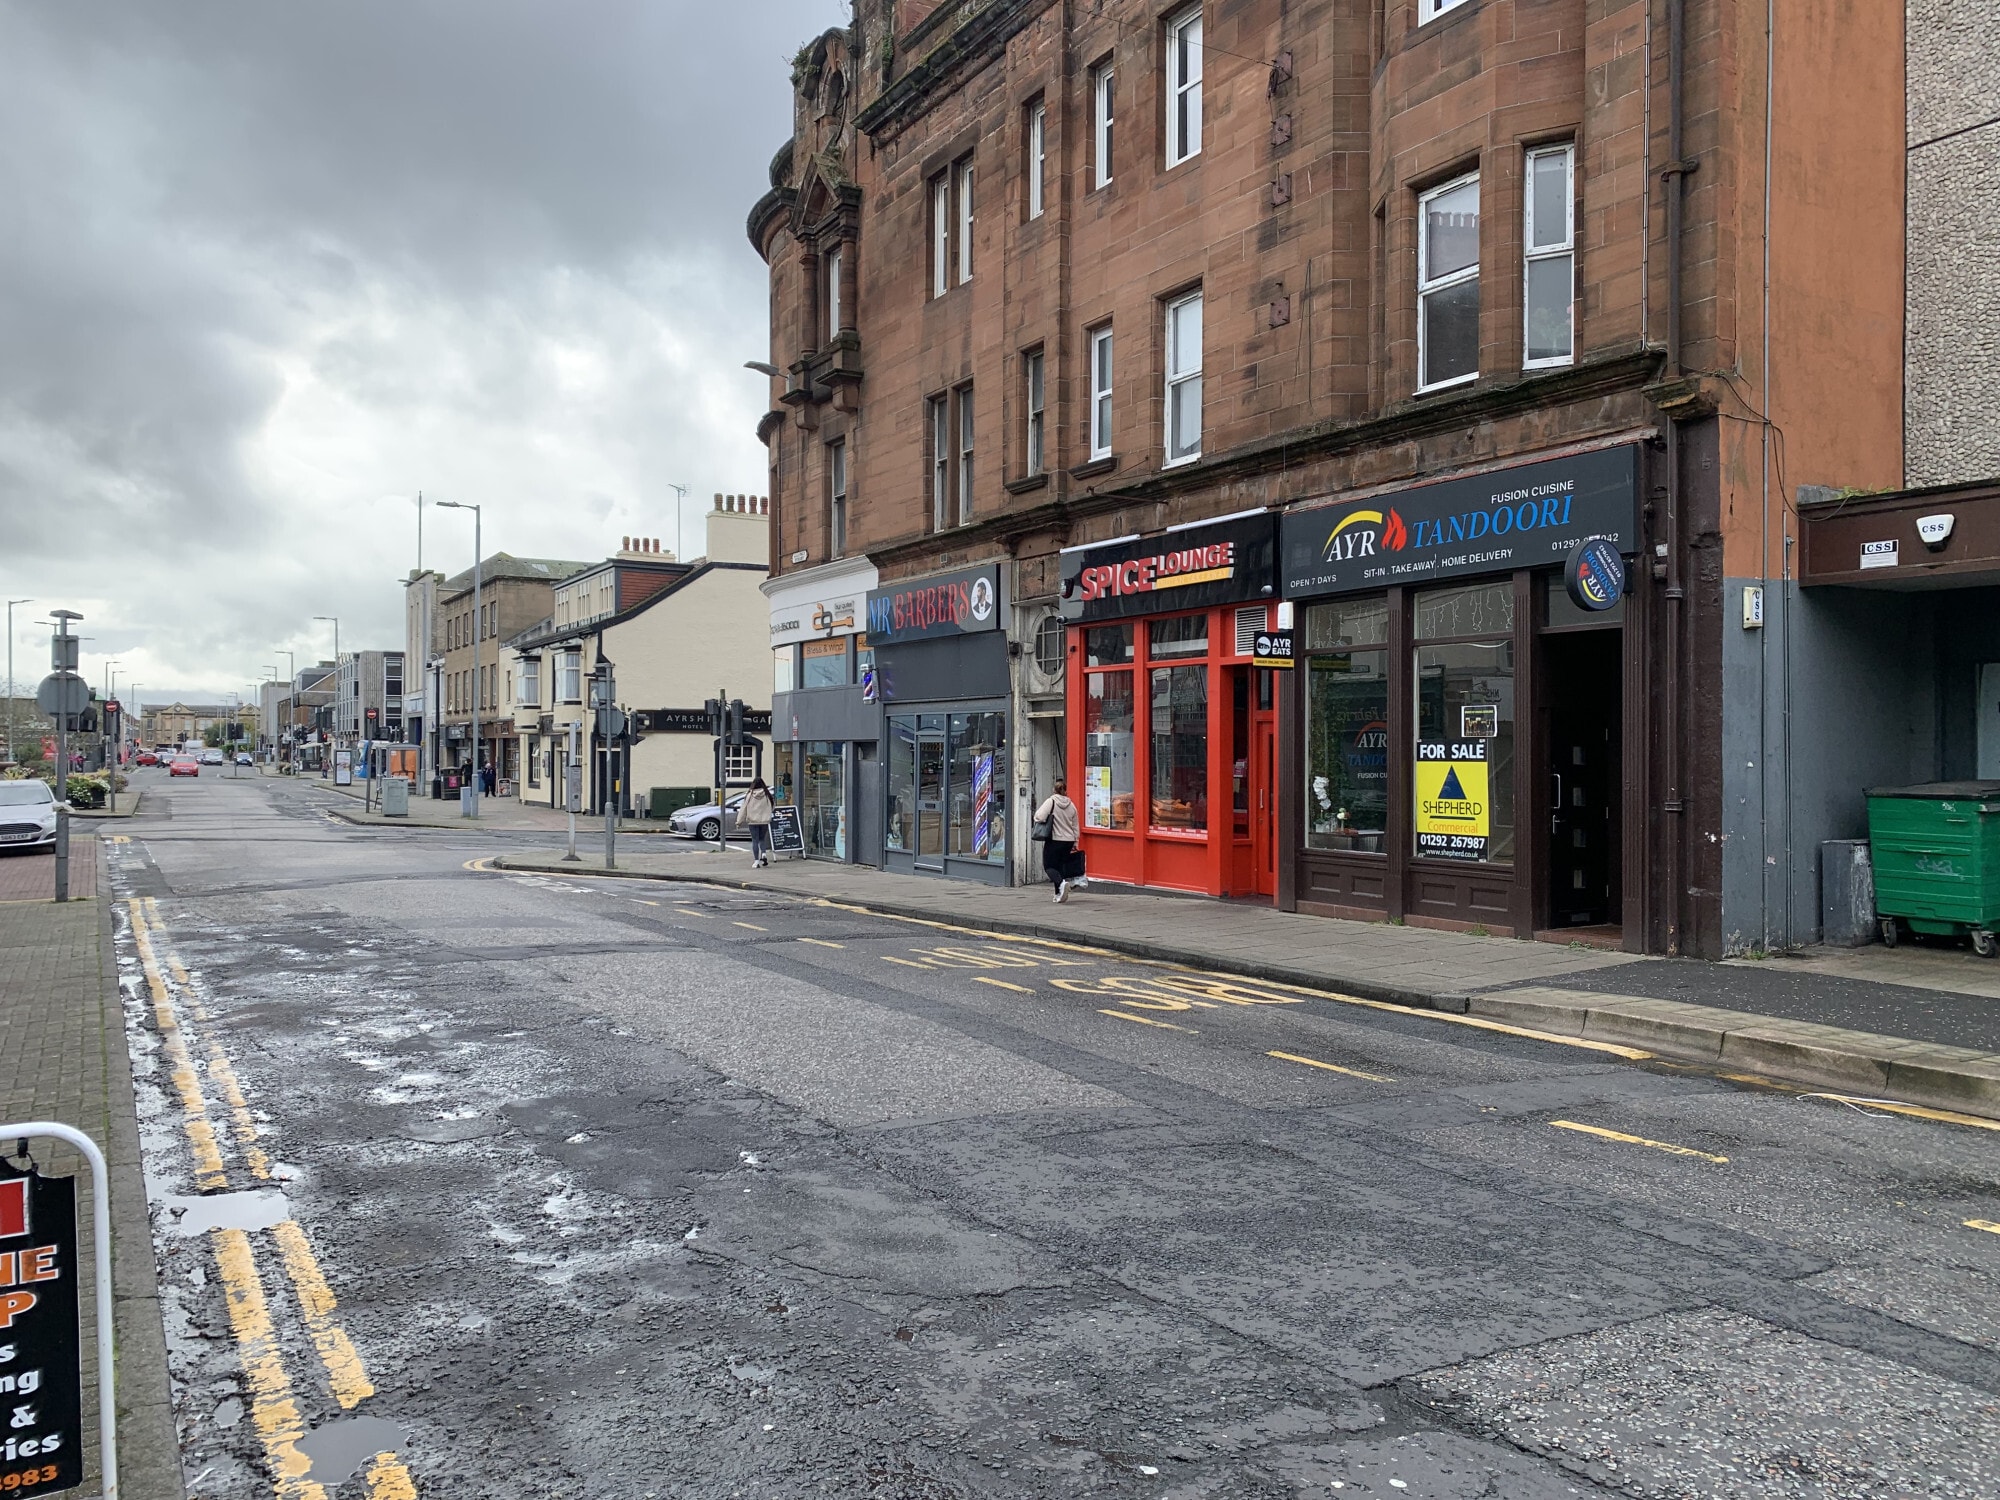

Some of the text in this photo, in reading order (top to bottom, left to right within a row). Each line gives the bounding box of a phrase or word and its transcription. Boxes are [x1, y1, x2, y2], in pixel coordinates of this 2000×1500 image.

[1491, 480, 1575, 504] FUSION CUISINE
[1326, 494, 1574, 562] AYR TANDOORI
[1551, 538, 1580, 550] 01292
[1081, 557, 1157, 601] SPICE
[1156, 542, 1234, 576] LOUNGE
[1363, 567, 1386, 579] SIT-IN
[1441, 555, 1467, 567] HOME
[1468, 548, 1513, 563] DELIVERY
[1585, 550, 1617, 599] TANDOORI
[1290, 574, 1337, 588] OPEN 7 DAYS
[1587, 574, 1606, 598] AYR
[869, 581, 969, 635] MR BARBERS
[1271, 647, 1291, 656] EATS
[1272, 638, 1291, 647] AYR
[1358, 732, 1388, 748] AYR
[1419, 744, 1485, 760] FOR SALE
[1423, 800, 1483, 816] SHEPHERD
[1427, 820, 1479, 834] Commercial
[1420, 834, 1485, 849] 01292 267987
[1425, 848, 1479, 859] www.shepherd.co.uk
[1048, 975, 1306, 1011] BUS
[10, 1405, 36, 1428] &
[0, 1434, 60, 1461] ies
[0, 1465, 58, 1491] 983
